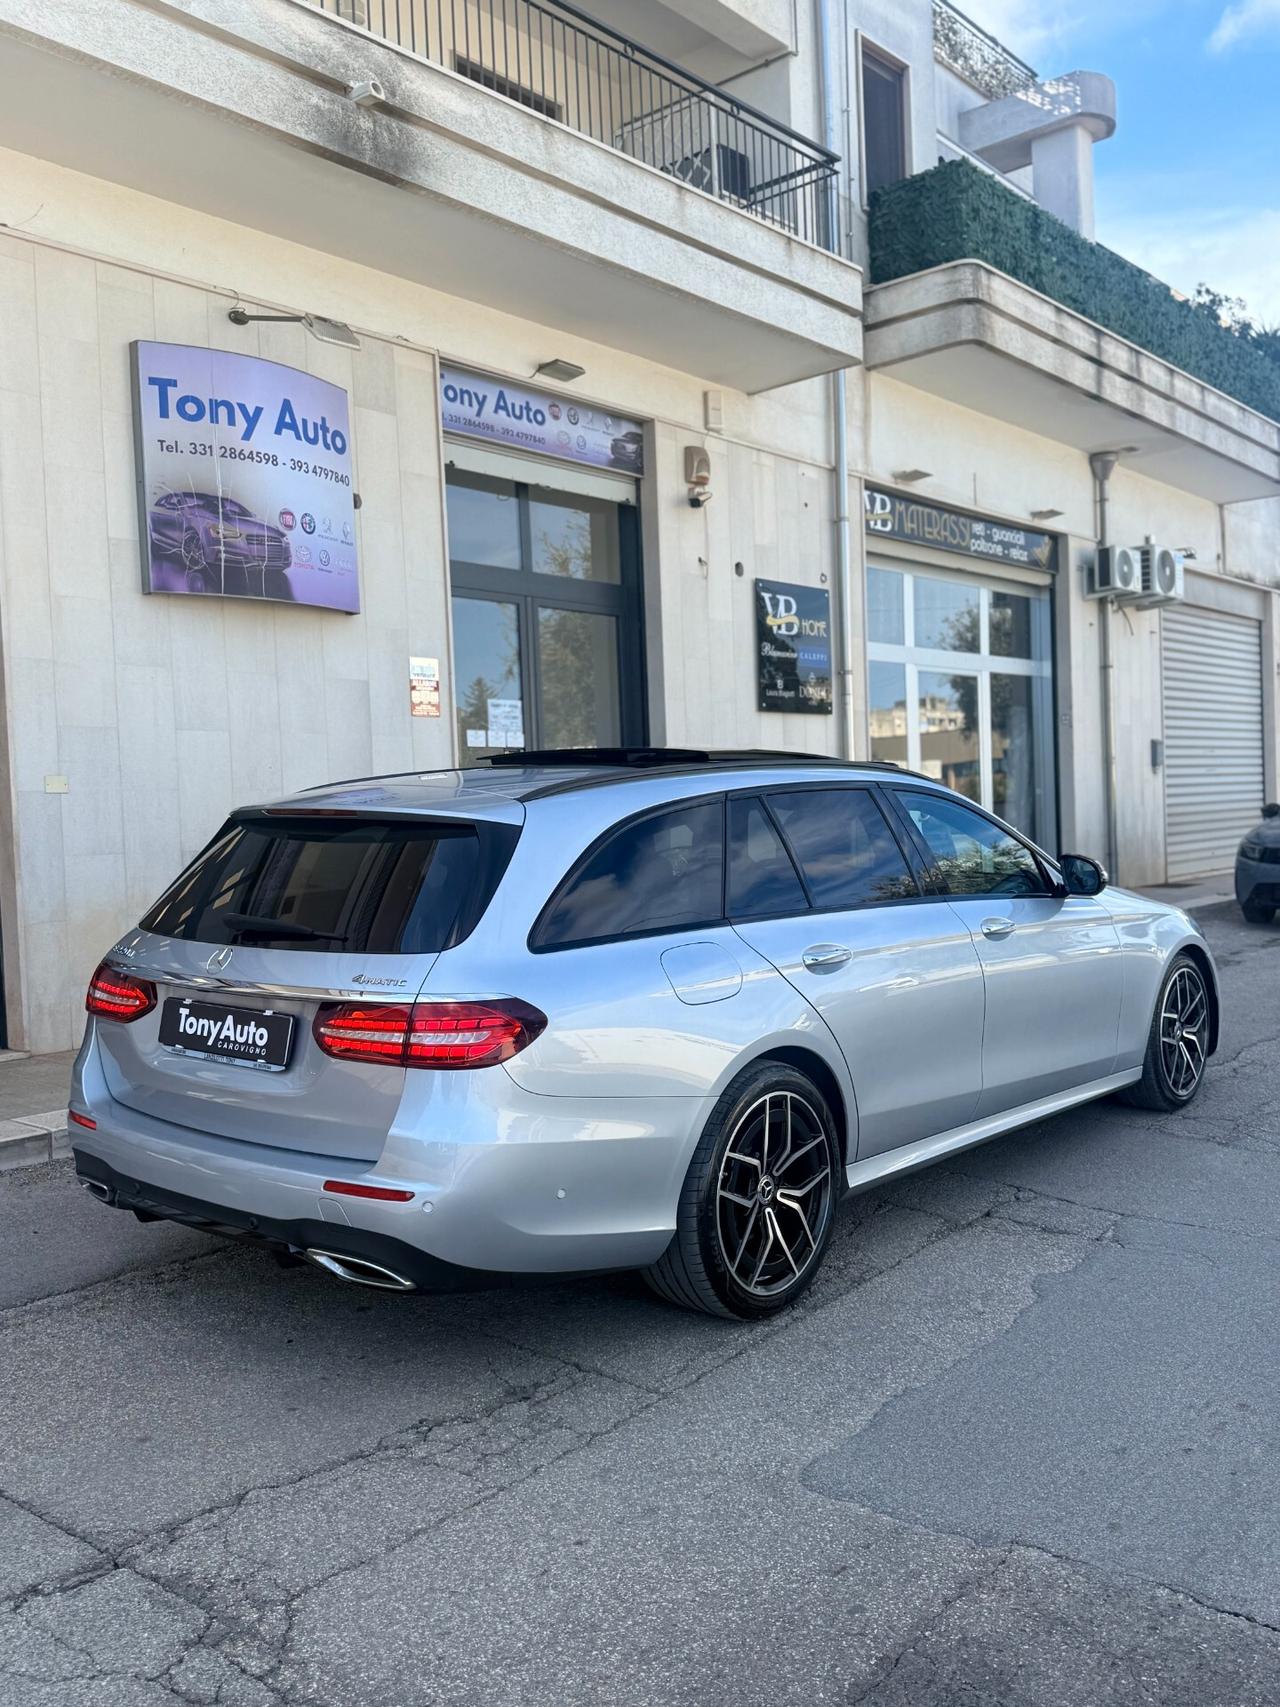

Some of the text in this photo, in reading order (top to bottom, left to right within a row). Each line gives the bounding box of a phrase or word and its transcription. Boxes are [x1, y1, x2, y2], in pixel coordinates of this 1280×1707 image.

[148, 376, 347, 455] Tony Auto
[440, 373, 546, 426] ony Auto
[157, 439, 184, 454] Tel.
[189, 442, 213, 457] 331
[219, 446, 279, 467] 2864598
[290, 458, 310, 474] 393
[312, 464, 350, 487] 4797840
[894, 501, 971, 547] MATERASSI
[970, 537, 1003, 556] poltrone
[1009, 546, 1028, 561] relax
[801, 618, 828, 638] HOME
[217, 1040, 267, 1056] CAROVIGNO
